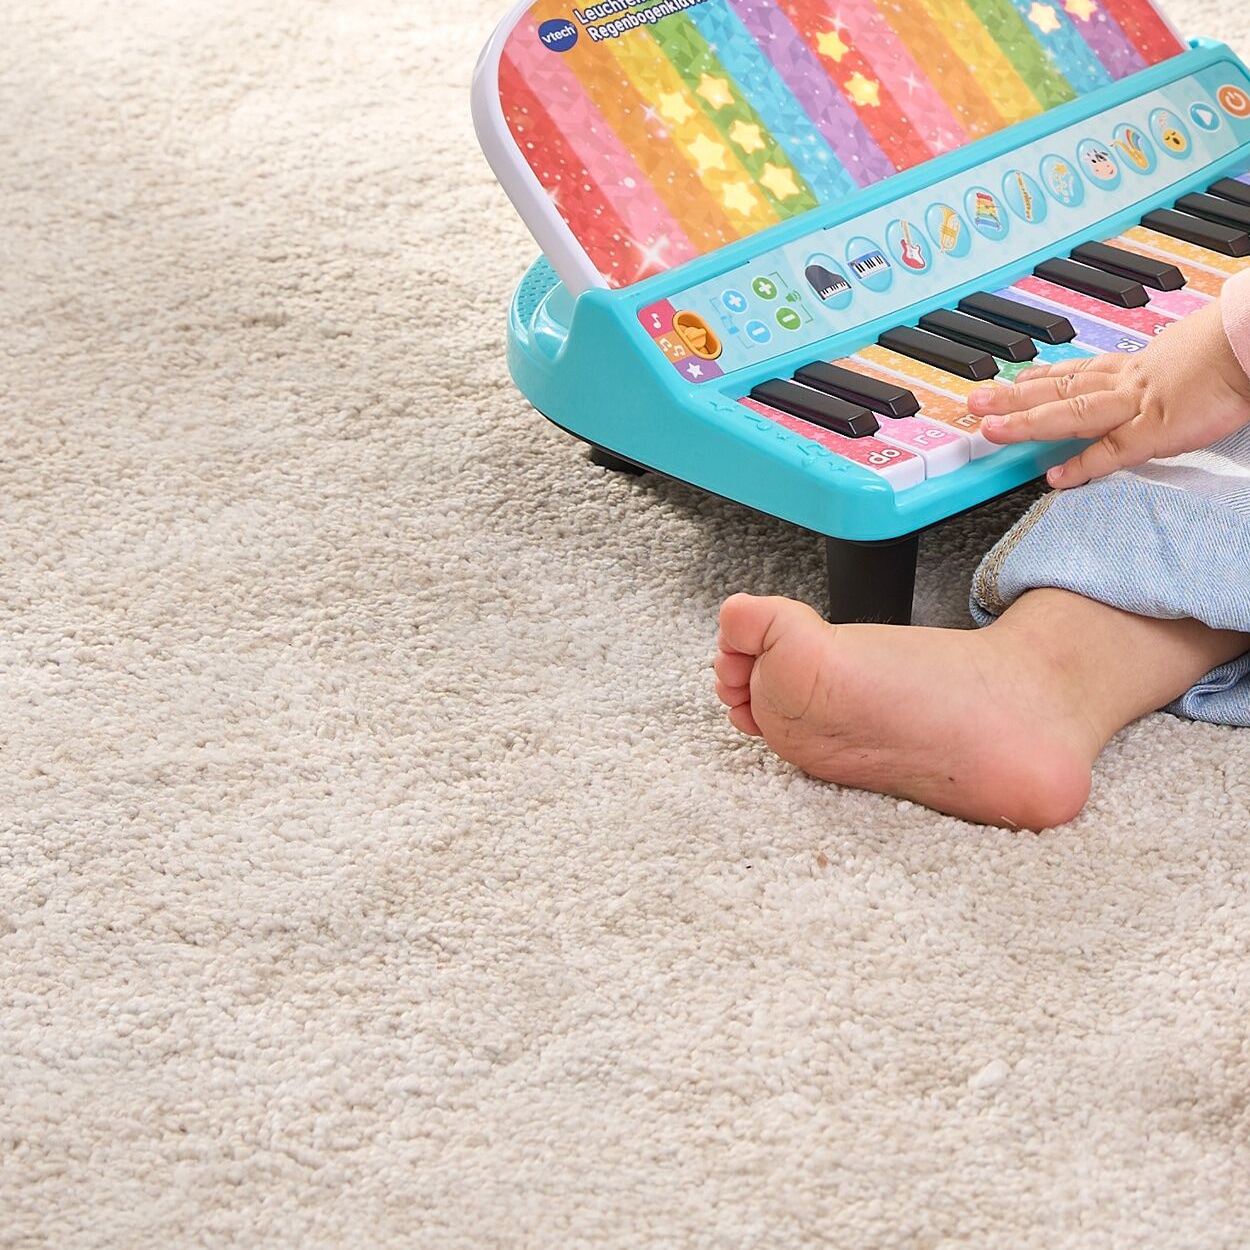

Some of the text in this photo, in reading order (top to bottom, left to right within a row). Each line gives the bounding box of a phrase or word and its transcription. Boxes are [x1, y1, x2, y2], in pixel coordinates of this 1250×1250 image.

[1115, 337, 1147, 352] si
[953, 413, 982, 428] m
[867, 448, 902, 465] do
